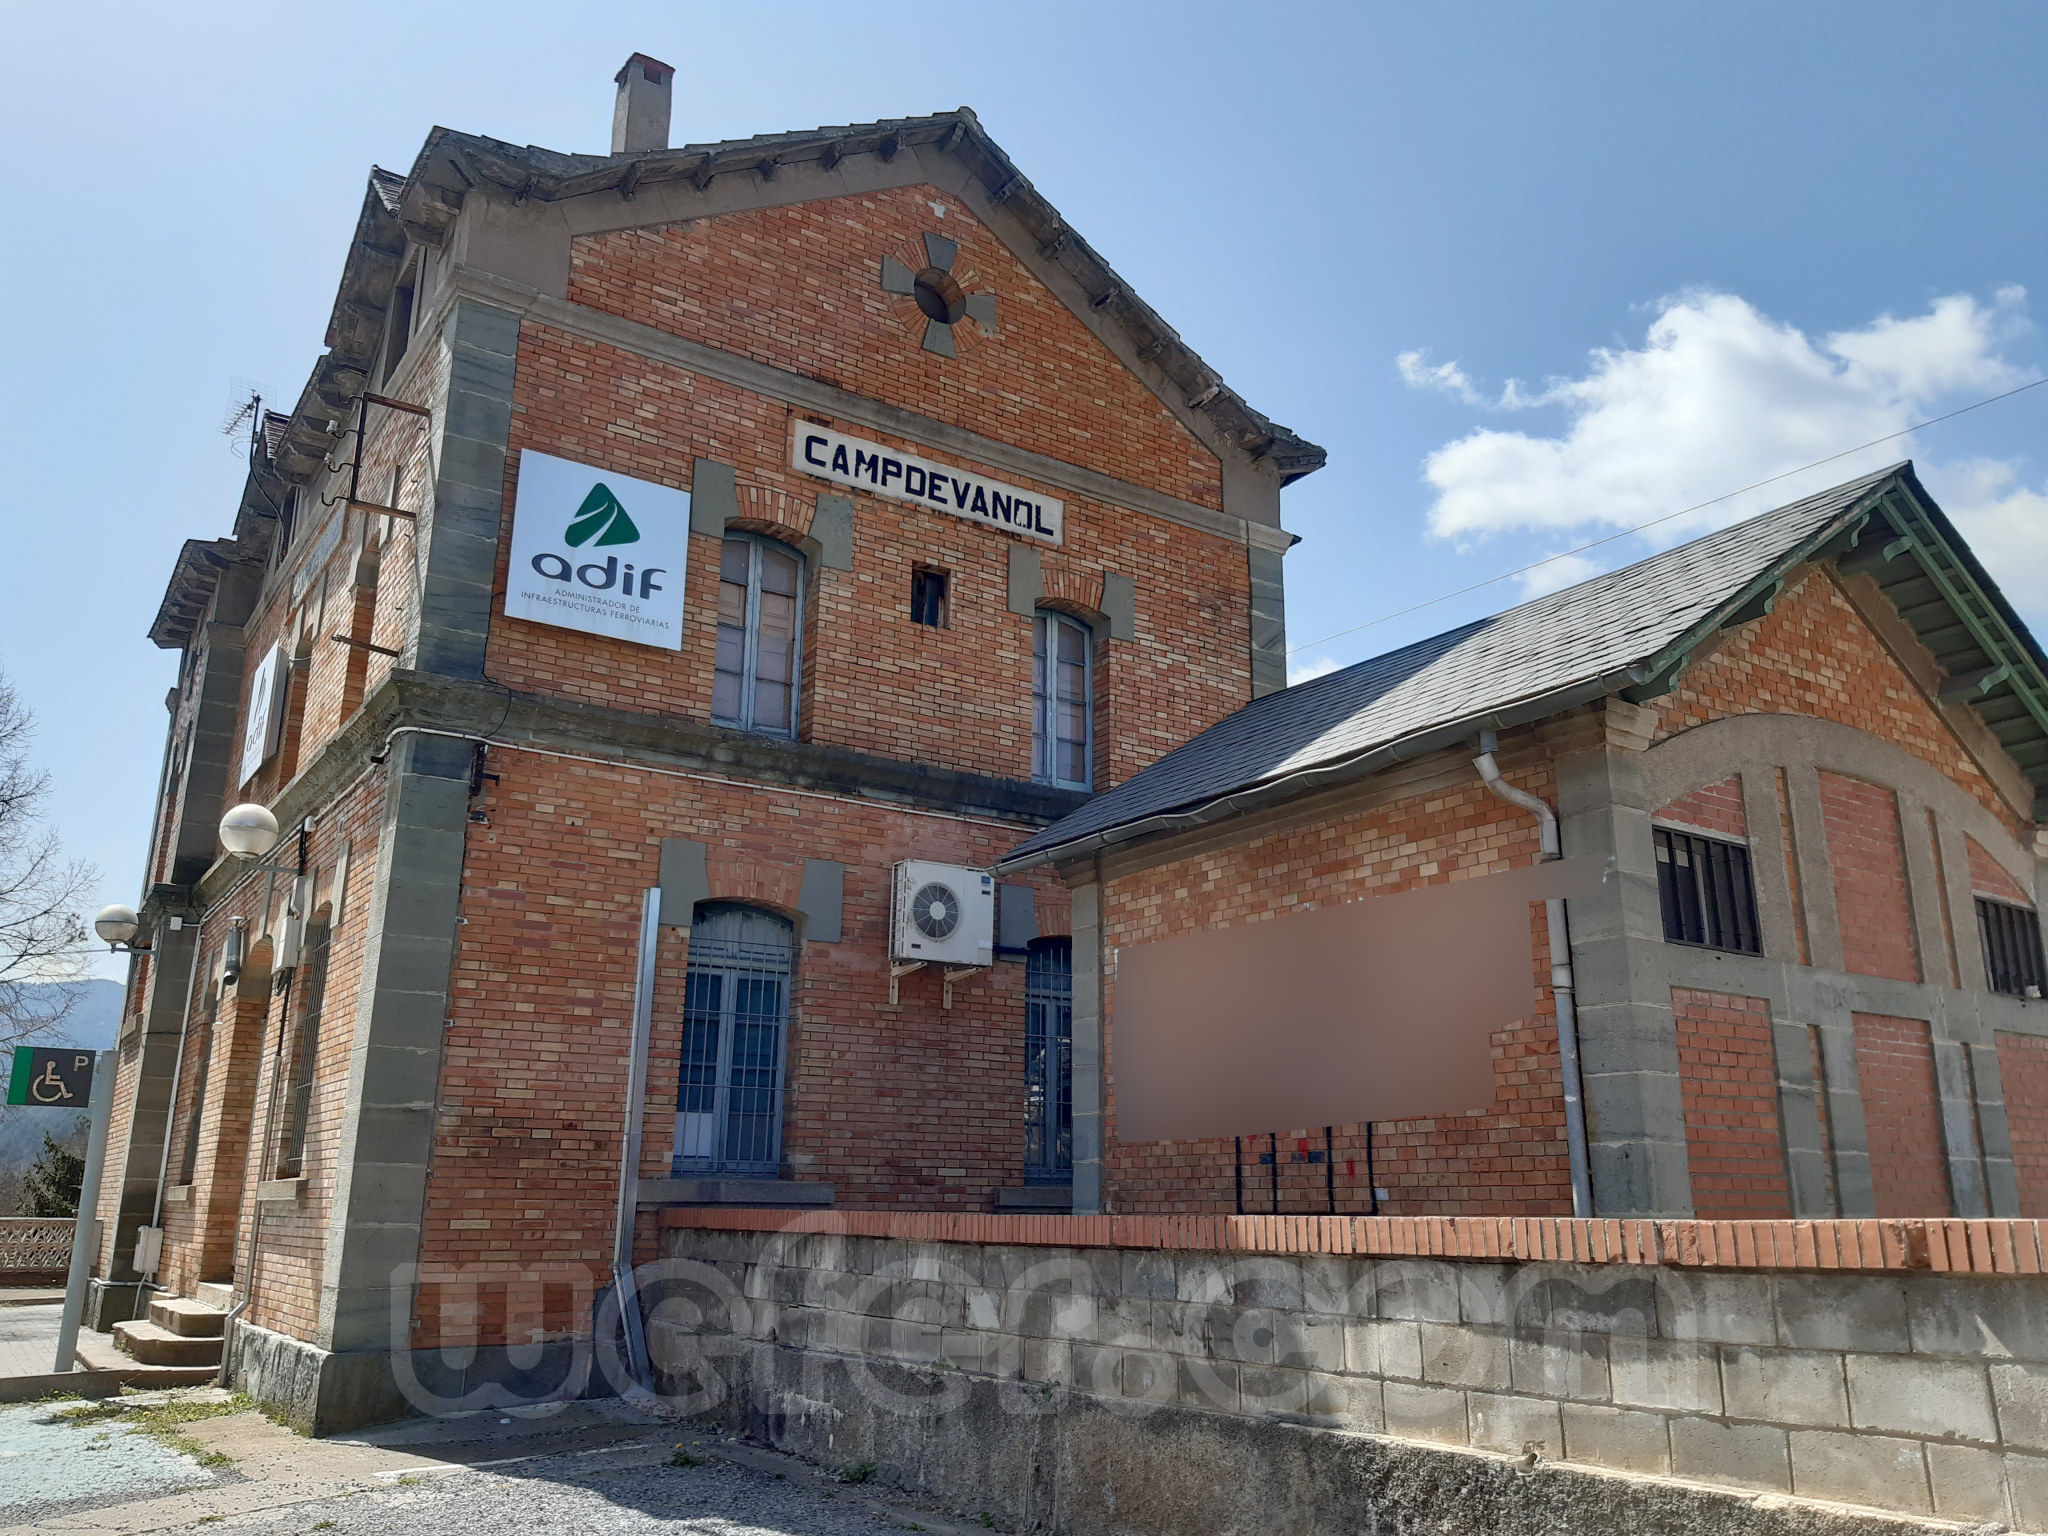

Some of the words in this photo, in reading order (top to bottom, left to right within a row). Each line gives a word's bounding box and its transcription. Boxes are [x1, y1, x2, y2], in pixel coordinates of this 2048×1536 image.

[804, 435, 1054, 537] CAMPDEVANOL
[531, 553, 667, 600] adif
[520, 590, 608, 616] INFRAESTRUCTURAS
[610, 610, 670, 630] FERROVIARIAS
[554, 588, 627, 611] ADMINISTRADOR
[629, 604, 641, 613] DE
[73, 1055, 89, 1072] P
